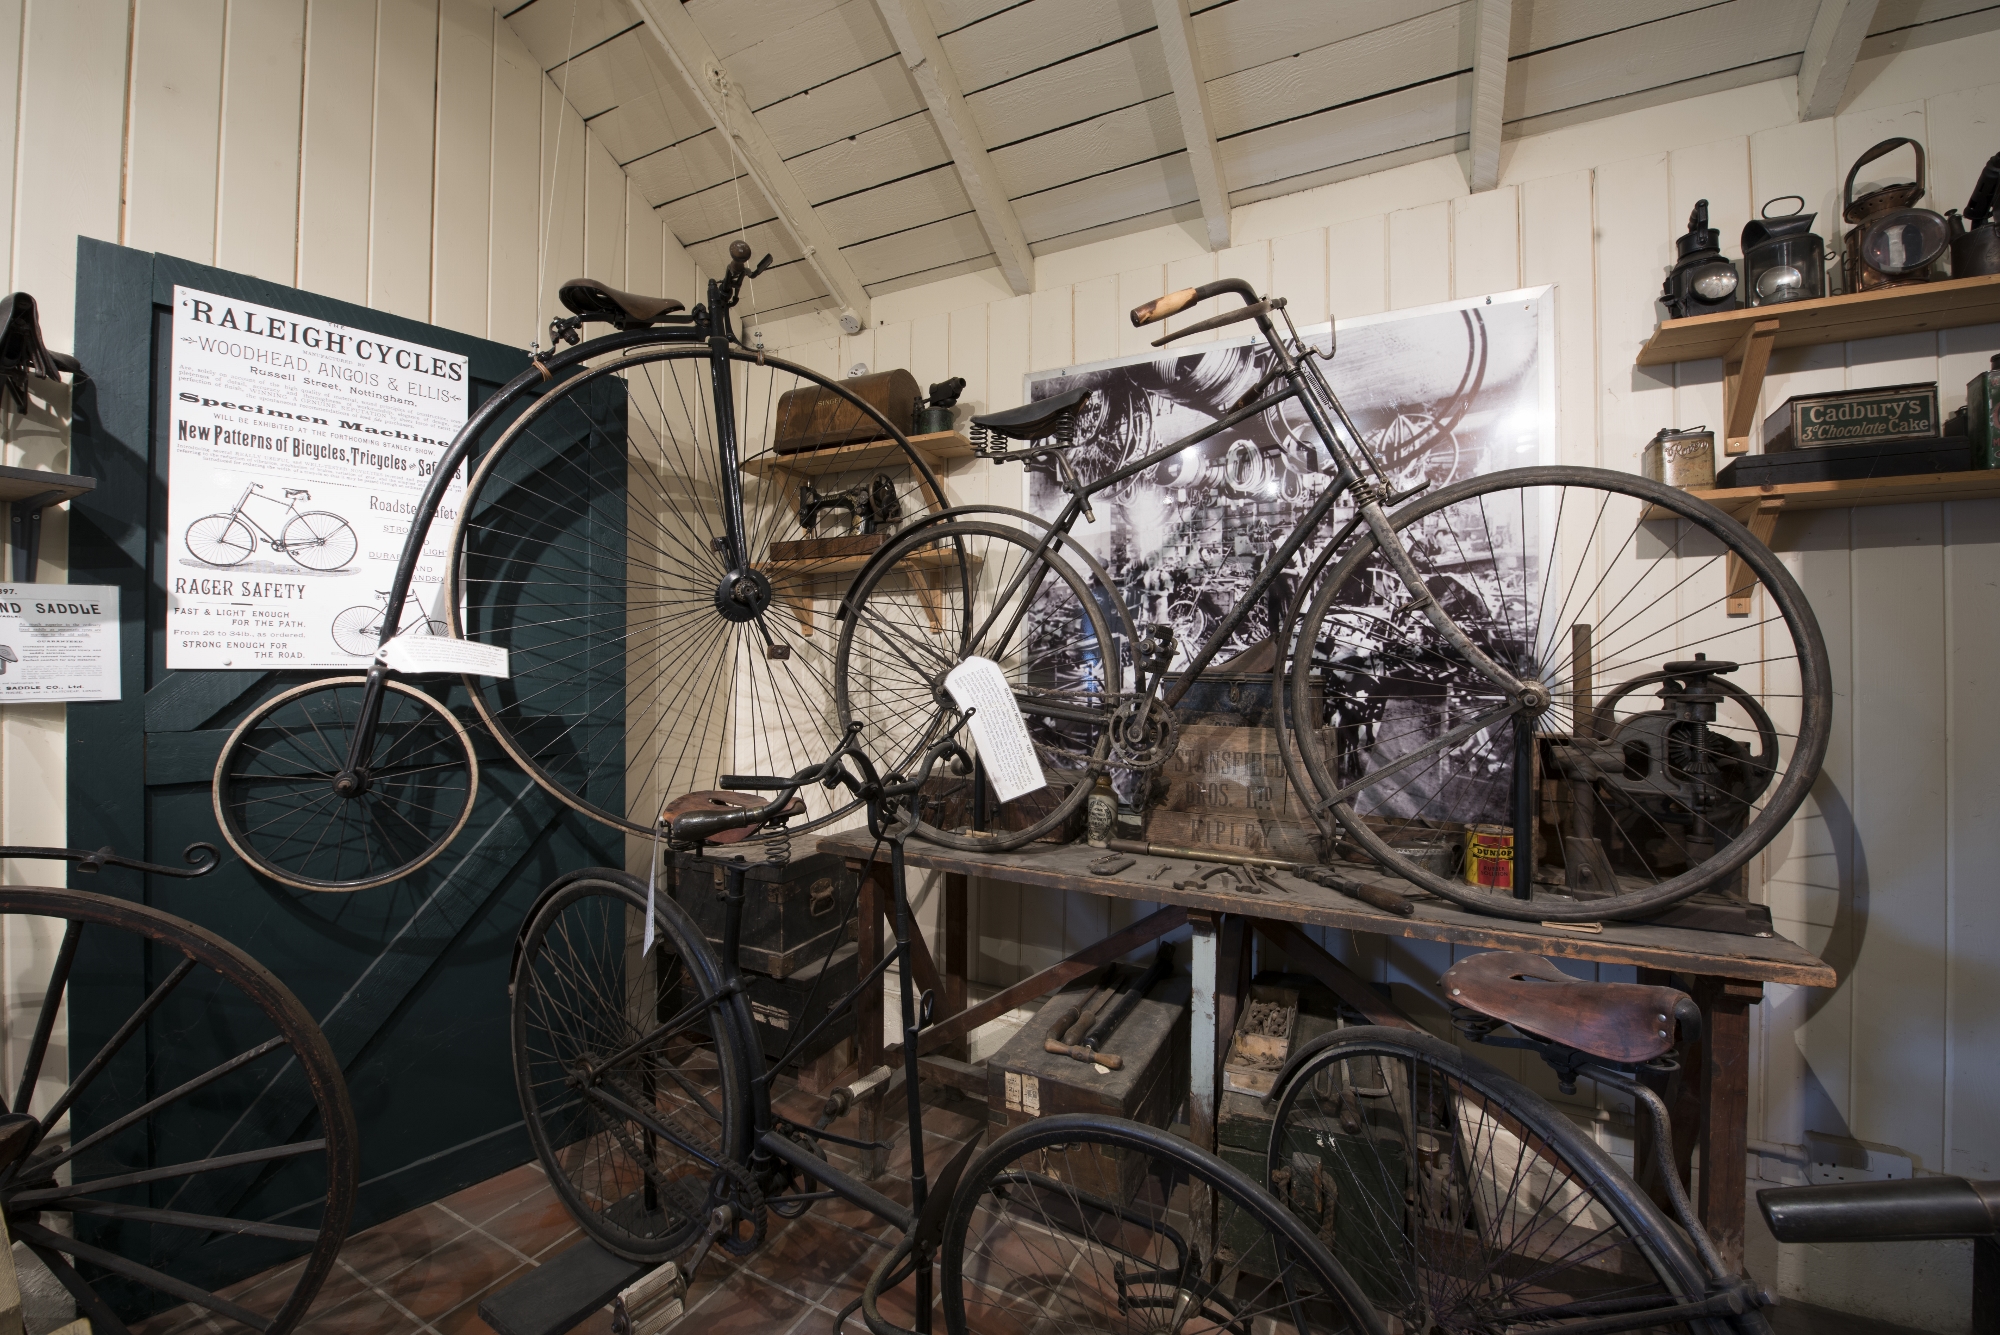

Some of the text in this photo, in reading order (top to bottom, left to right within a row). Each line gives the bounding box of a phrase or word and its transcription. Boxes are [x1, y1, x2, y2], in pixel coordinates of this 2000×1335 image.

[198, 335, 449, 402] WOODHEAD, ANGOIS & ELLIS
[356, 339, 461, 381] CYCLES
[250, 365, 417, 407] Russell Street, Nottingham.
[179, 392, 450, 447] Specimen Machine
[1810, 400, 1922, 422] Cadbury's
[213, 412, 233, 421] WILL
[253, 419, 294, 431] EXHIBITED
[330, 432, 379, 446] FORTHCOMING
[382, 441, 411, 451] STANLEY
[1818, 422, 1886, 439] Chocolate
[1888, 418, 1929, 433] Cake
[178, 419, 210, 441] New
[214, 425, 272, 450] Patterns
[275, 436, 289, 452] of
[292, 437, 349, 463] Bicycles,
[350, 446, 406, 471] Tricycles
[370, 495, 416, 515] Roadste
[384, 524, 408, 533] STRO
[369, 551, 400, 560] DURA
[175, 577, 305, 599] RACER SAFETY
[36, 603, 102, 614] SADDLE
[174, 606, 198, 615] FAST
[1174, 749, 1286, 778] STANSFIELD
[1186, 782, 1233, 808] BROS.
